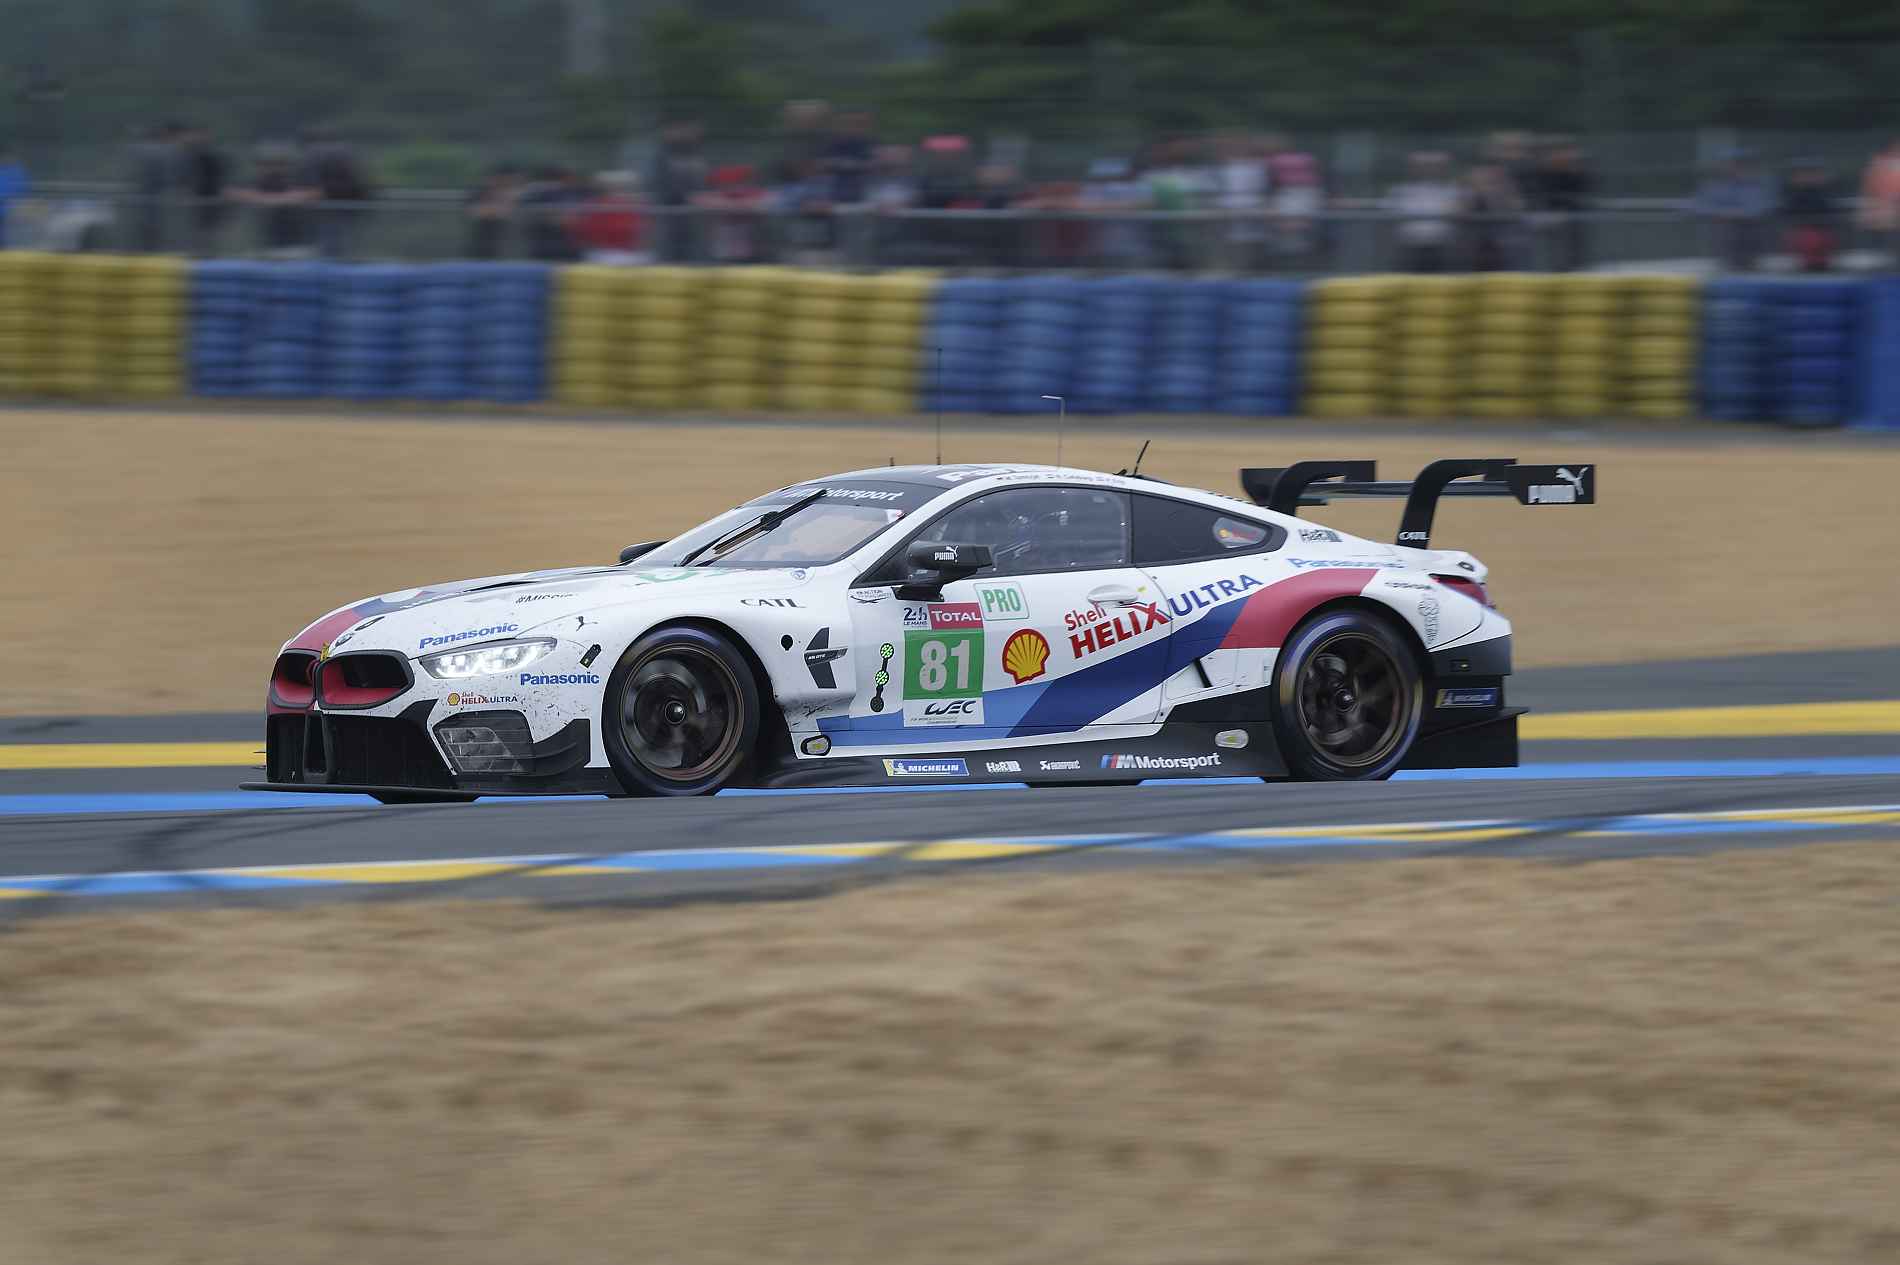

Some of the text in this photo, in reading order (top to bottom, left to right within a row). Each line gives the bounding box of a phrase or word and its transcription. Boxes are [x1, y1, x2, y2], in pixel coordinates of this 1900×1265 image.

[740, 598, 806, 609] CATL
[982, 588, 1021, 613] PRO
[931, 609, 981, 622] TOTAL
[1064, 600, 1107, 631] Shell
[1068, 574, 1264, 660] HELIX ULTRA
[419, 622, 519, 649] Panasonic
[919, 639, 970, 691] 81
[520, 672, 600, 686] Panasonic
[461, 695, 518, 705] HELIX ULTRA
[924, 700, 977, 715] WEC
[908, 764, 959, 772] MICHELIN
[1135, 752, 1222, 770] Motorsport
